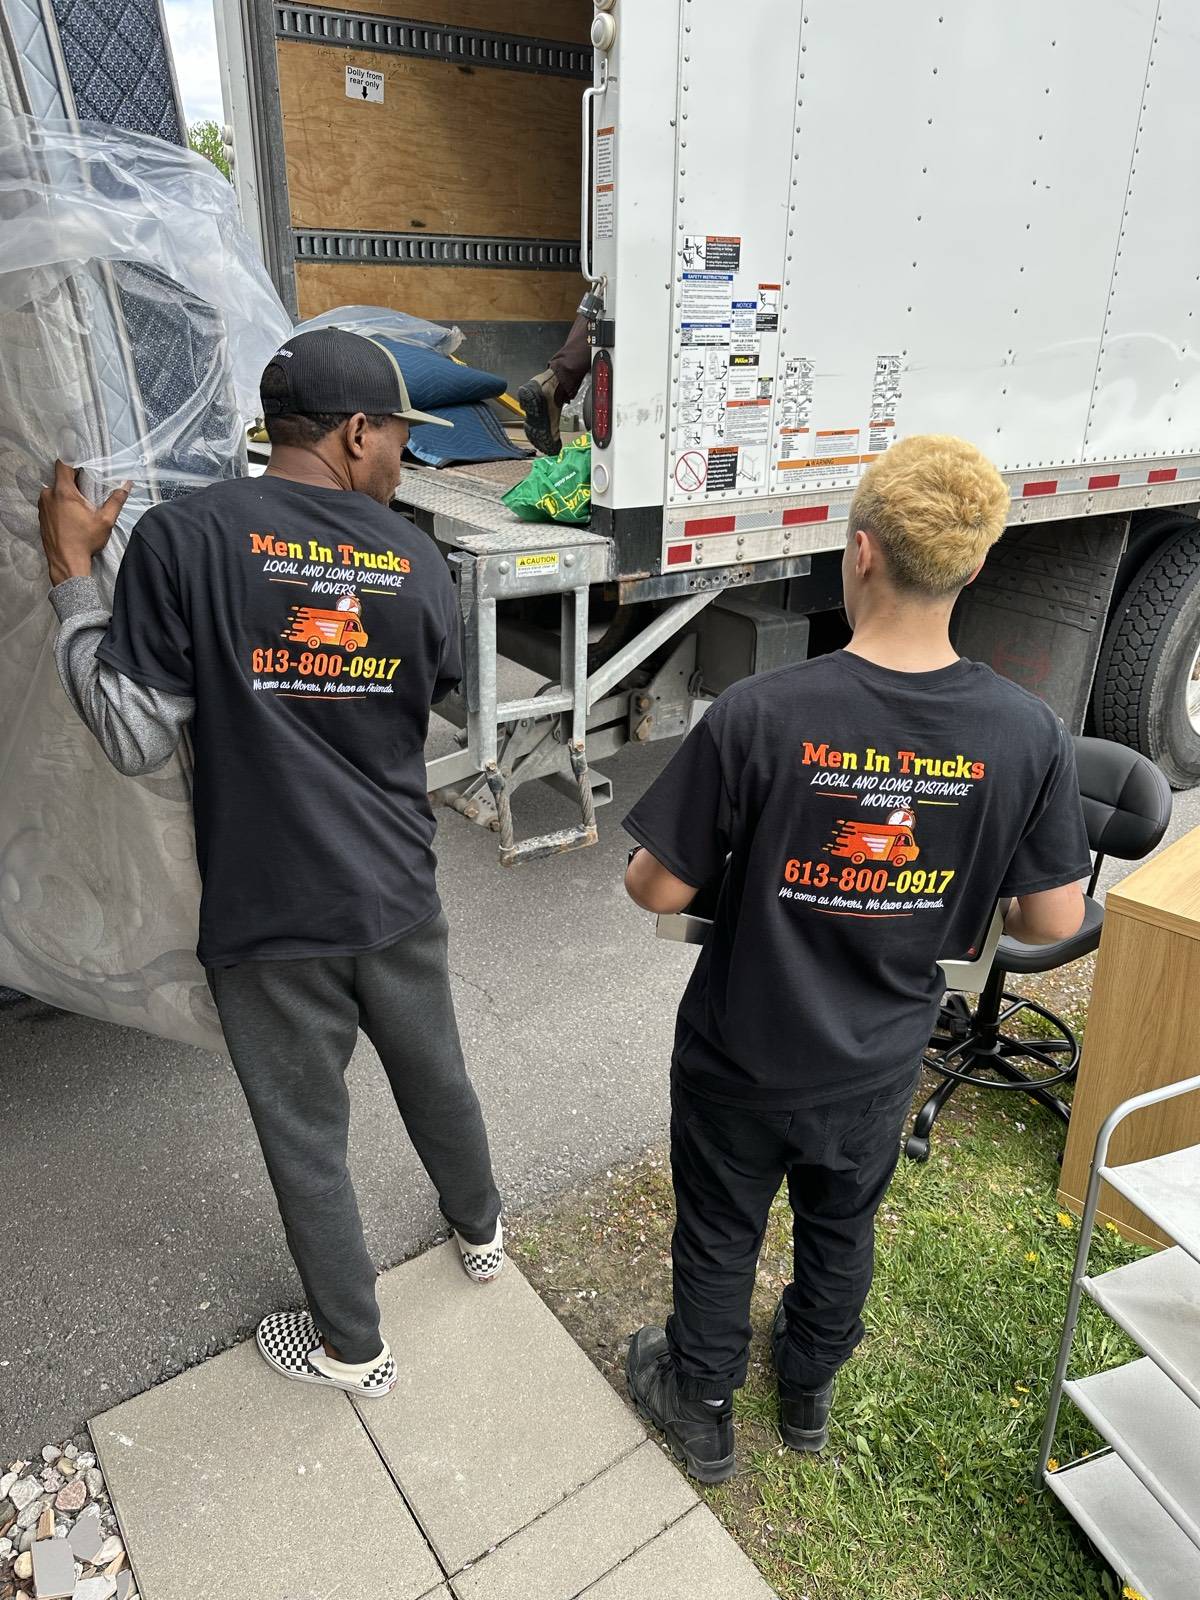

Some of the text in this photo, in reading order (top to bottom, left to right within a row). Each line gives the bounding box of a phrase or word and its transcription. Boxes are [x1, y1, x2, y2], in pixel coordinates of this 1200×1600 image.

[347, 67, 383, 81] Dolly from
[365, 80, 380, 90] only
[810, 458, 835, 466] WARNING
[250, 533, 411, 574] Men In Trucks
[526, 555, 556, 565] CAUTION
[263, 560, 404, 587] LOCAL AND LONG DISTANCE
[311, 581, 356, 596] MOVERS
[252, 648, 401, 680] 613-800-0917
[253, 679, 394, 693] We come as Movers, We leave as Friends.
[802, 742, 985, 780] Men In Trucks
[810, 772, 973, 796] LOCAL AND LONG DISTANCE
[861, 794, 912, 809] MOVERS
[784, 859, 955, 894] 613-800-0917
[778, 887, 944, 910] We come as Movers, We leave as Friends.
